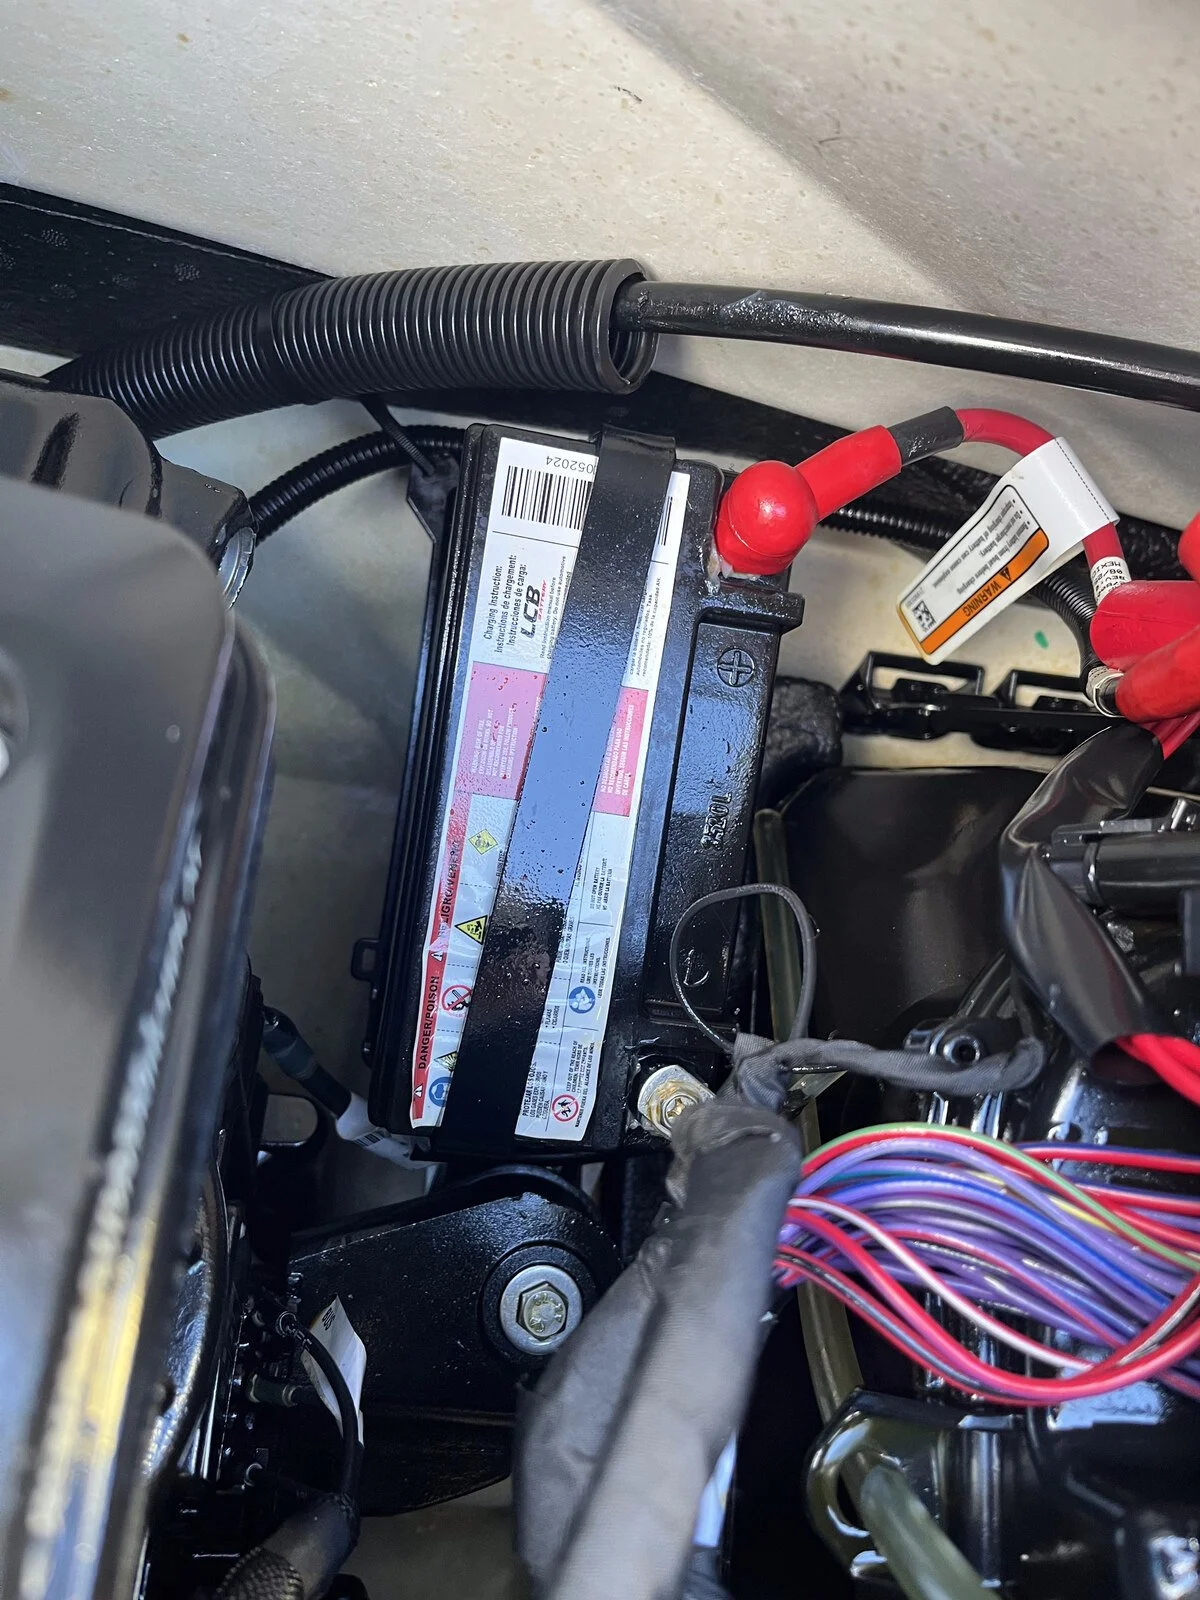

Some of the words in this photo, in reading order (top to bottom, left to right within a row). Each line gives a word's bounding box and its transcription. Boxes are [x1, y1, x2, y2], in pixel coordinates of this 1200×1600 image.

[966, 534, 985, 553] battery
[997, 544, 1011, 559] from
[516, 563, 528, 586] carga:
[974, 563, 990, 580] before
[987, 554, 1001, 568] boat
[488, 564, 502, 606] Instruction:
[502, 554, 517, 599] chargement:
[514, 587, 522, 596] de
[548, 576, 556, 594] before
[552, 606, 558, 614] Do
[557, 555, 566, 585] automotive
[500, 599, 509, 609] de
[519, 584, 542, 638] LCB
[961, 579, 1001, 617] WARNING
[483, 607, 498, 640] Charging
[493, 610, 508, 653] Instructions
[506, 597, 521, 645] Instrucciones
[418, 975, 439, 1069] DANGER/POISON
[522, 1089, 532, 1116] PROTEJAR
